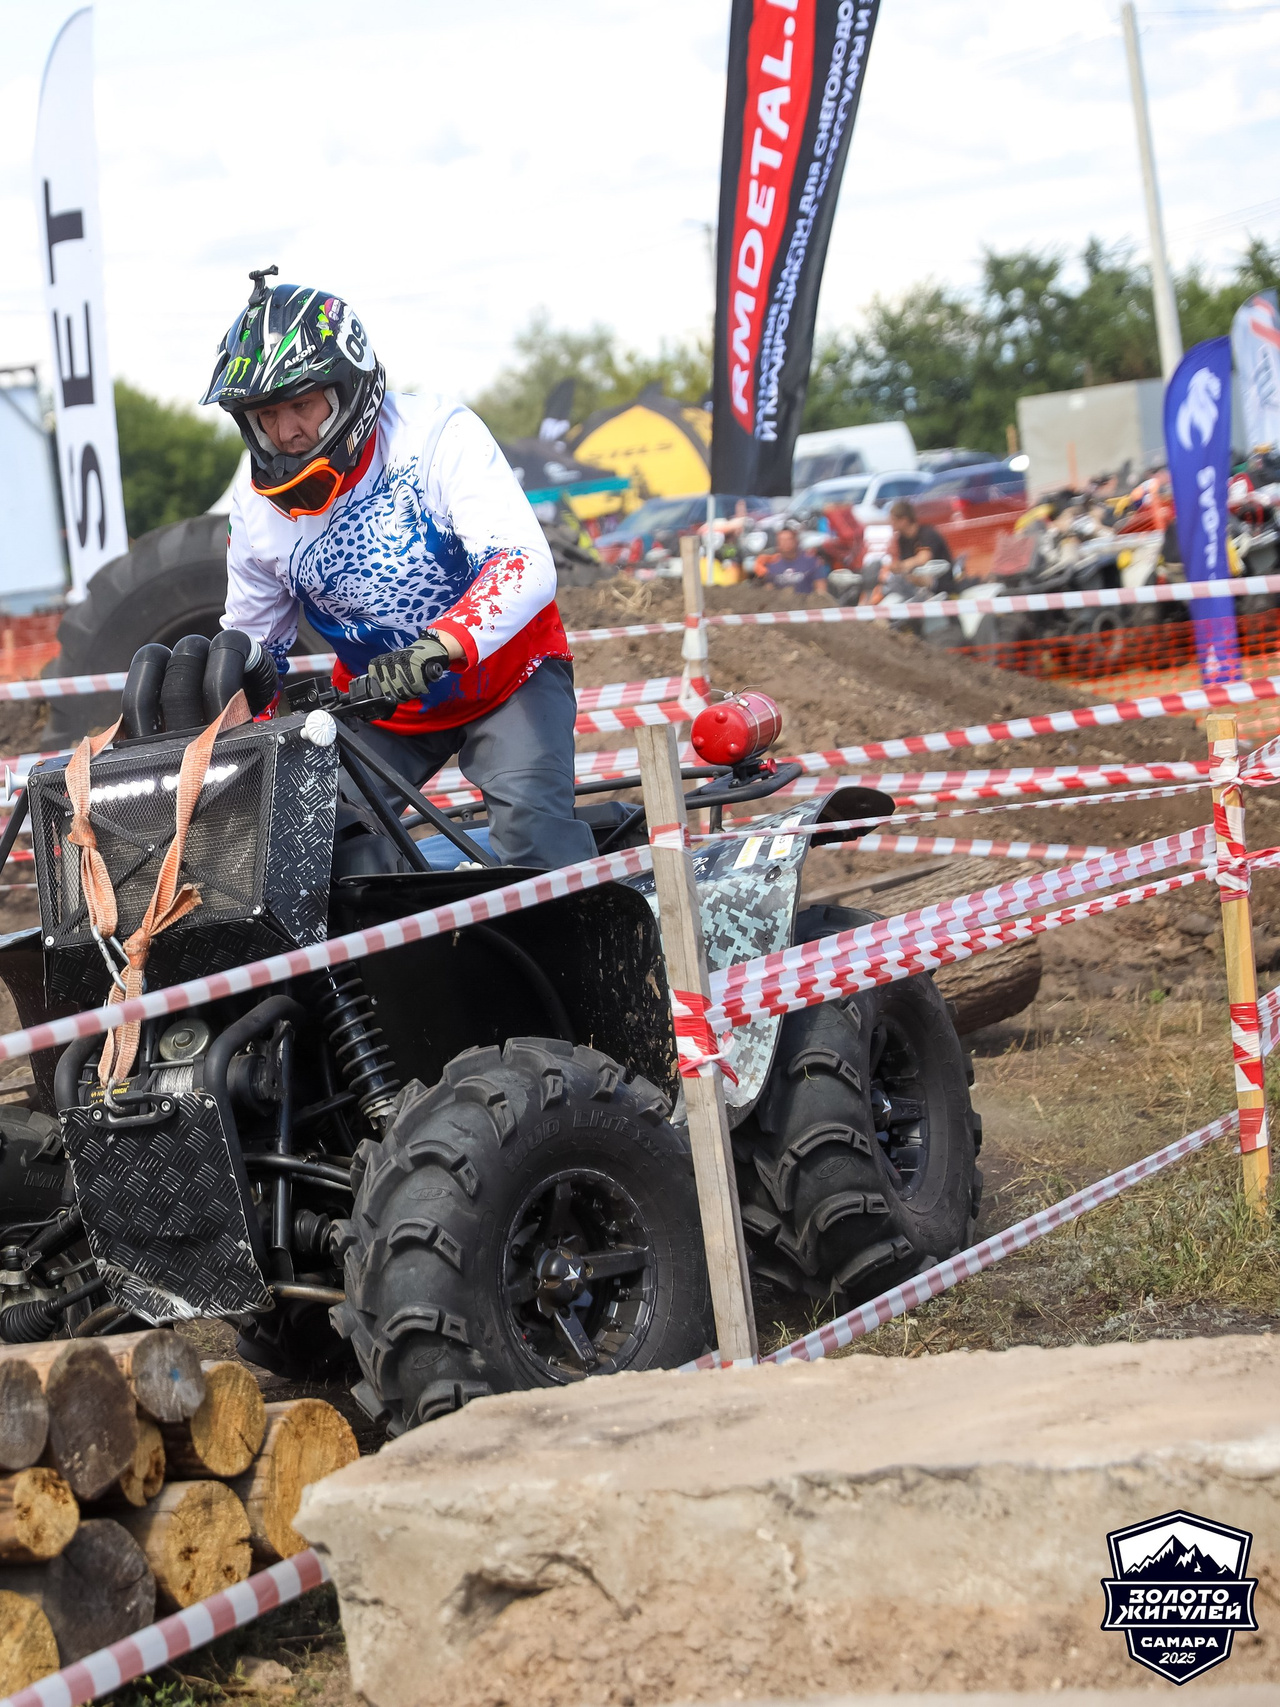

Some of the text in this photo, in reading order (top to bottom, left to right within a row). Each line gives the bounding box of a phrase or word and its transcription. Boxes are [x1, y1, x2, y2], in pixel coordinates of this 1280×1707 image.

[855, 9, 871, 31] И
[798, 161, 822, 214] ДЛЯ
[813, 0, 854, 157] СНЕГОХОДО
[731, 0, 798, 416] RMDETAL.
[284, 344, 316, 370] Airoh
[345, 318, 368, 363] 09
[43, 178, 106, 552] SET
[573, 1108, 638, 1139] LITE
